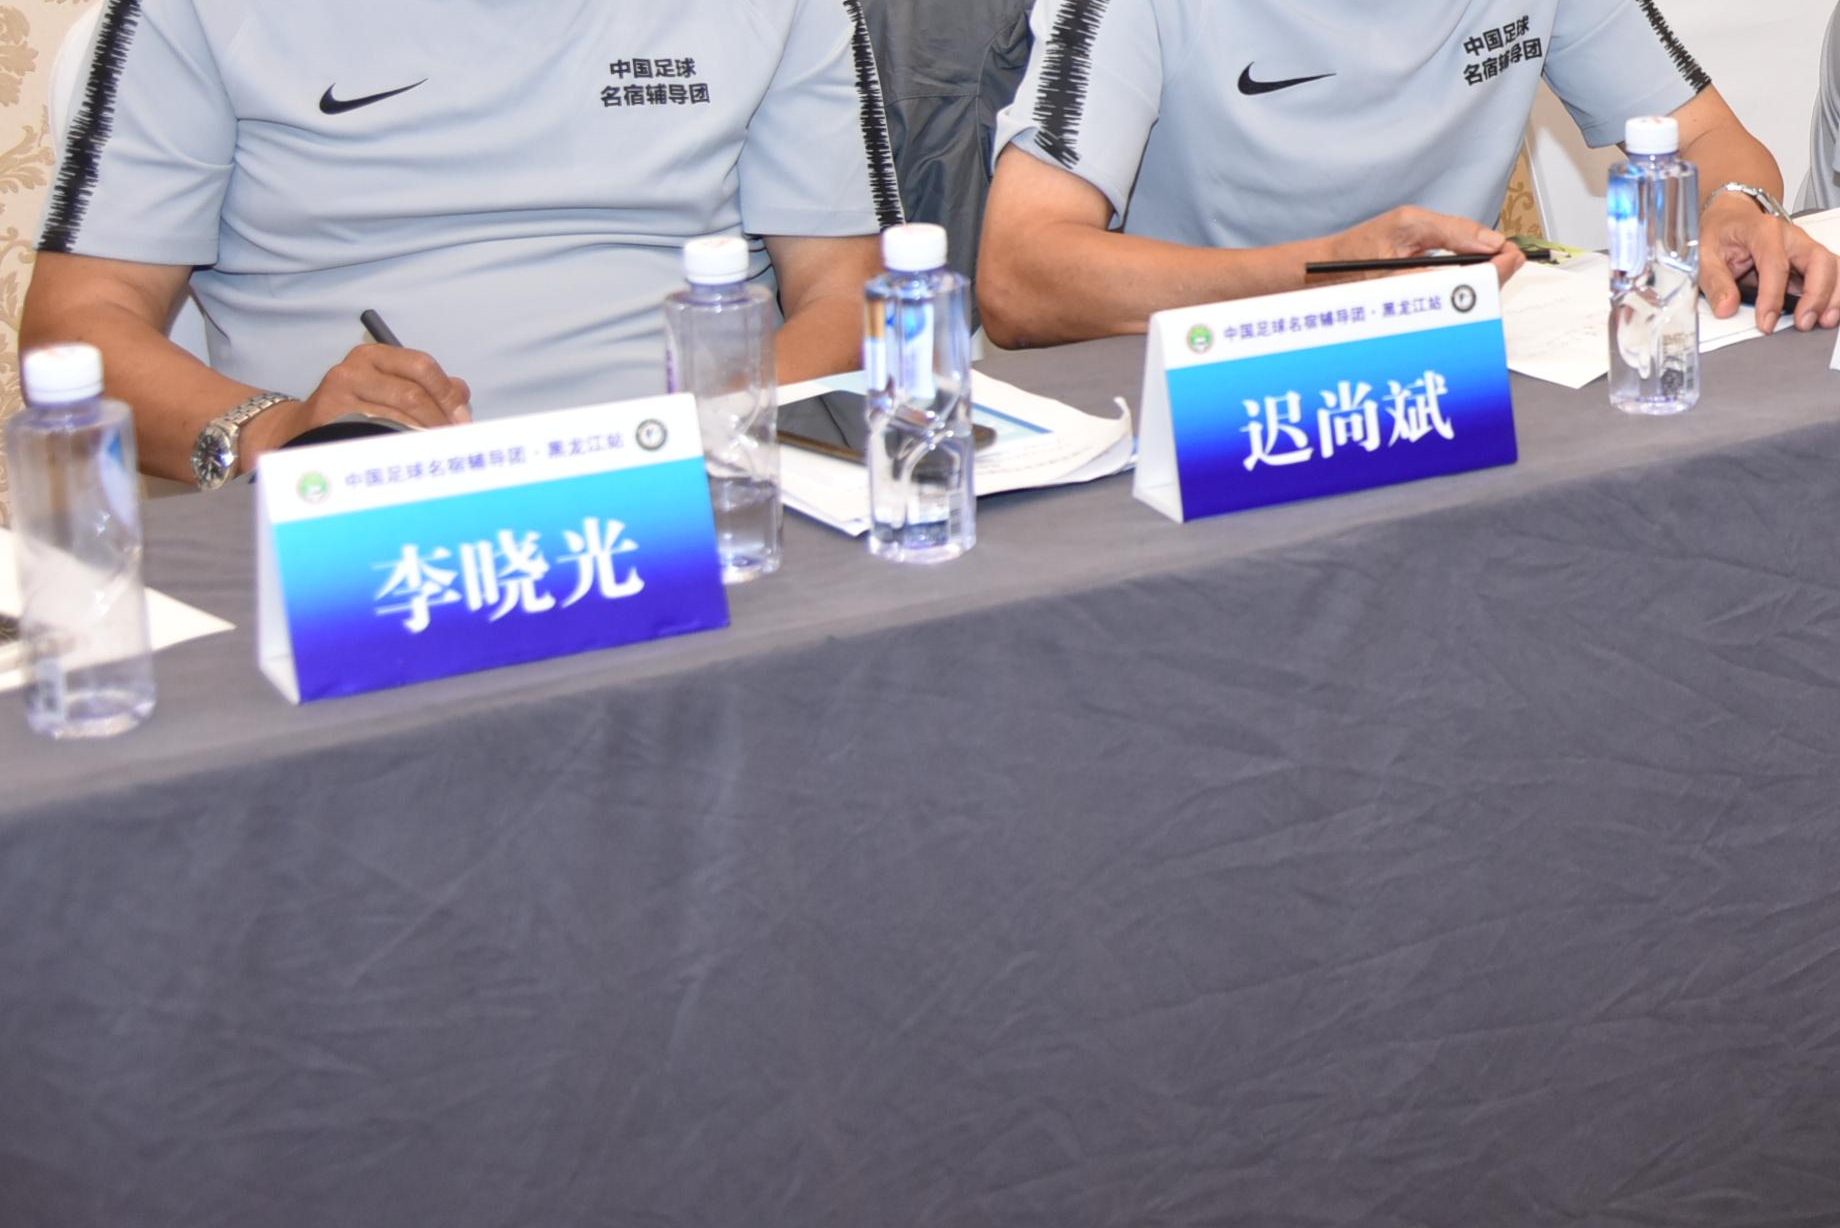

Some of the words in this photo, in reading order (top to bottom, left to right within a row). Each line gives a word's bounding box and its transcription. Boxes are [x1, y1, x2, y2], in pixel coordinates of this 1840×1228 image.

[1463, 15, 1530, 56] 中国足球
[609, 57, 697, 79] 中国足球
[1463, 37, 1542, 86] 名宿辅导团
[600, 82, 710, 107] 名宿辅导团
[1239, 370, 1455, 471] 迟尚斌
[371, 516, 645, 634] 李晓光
